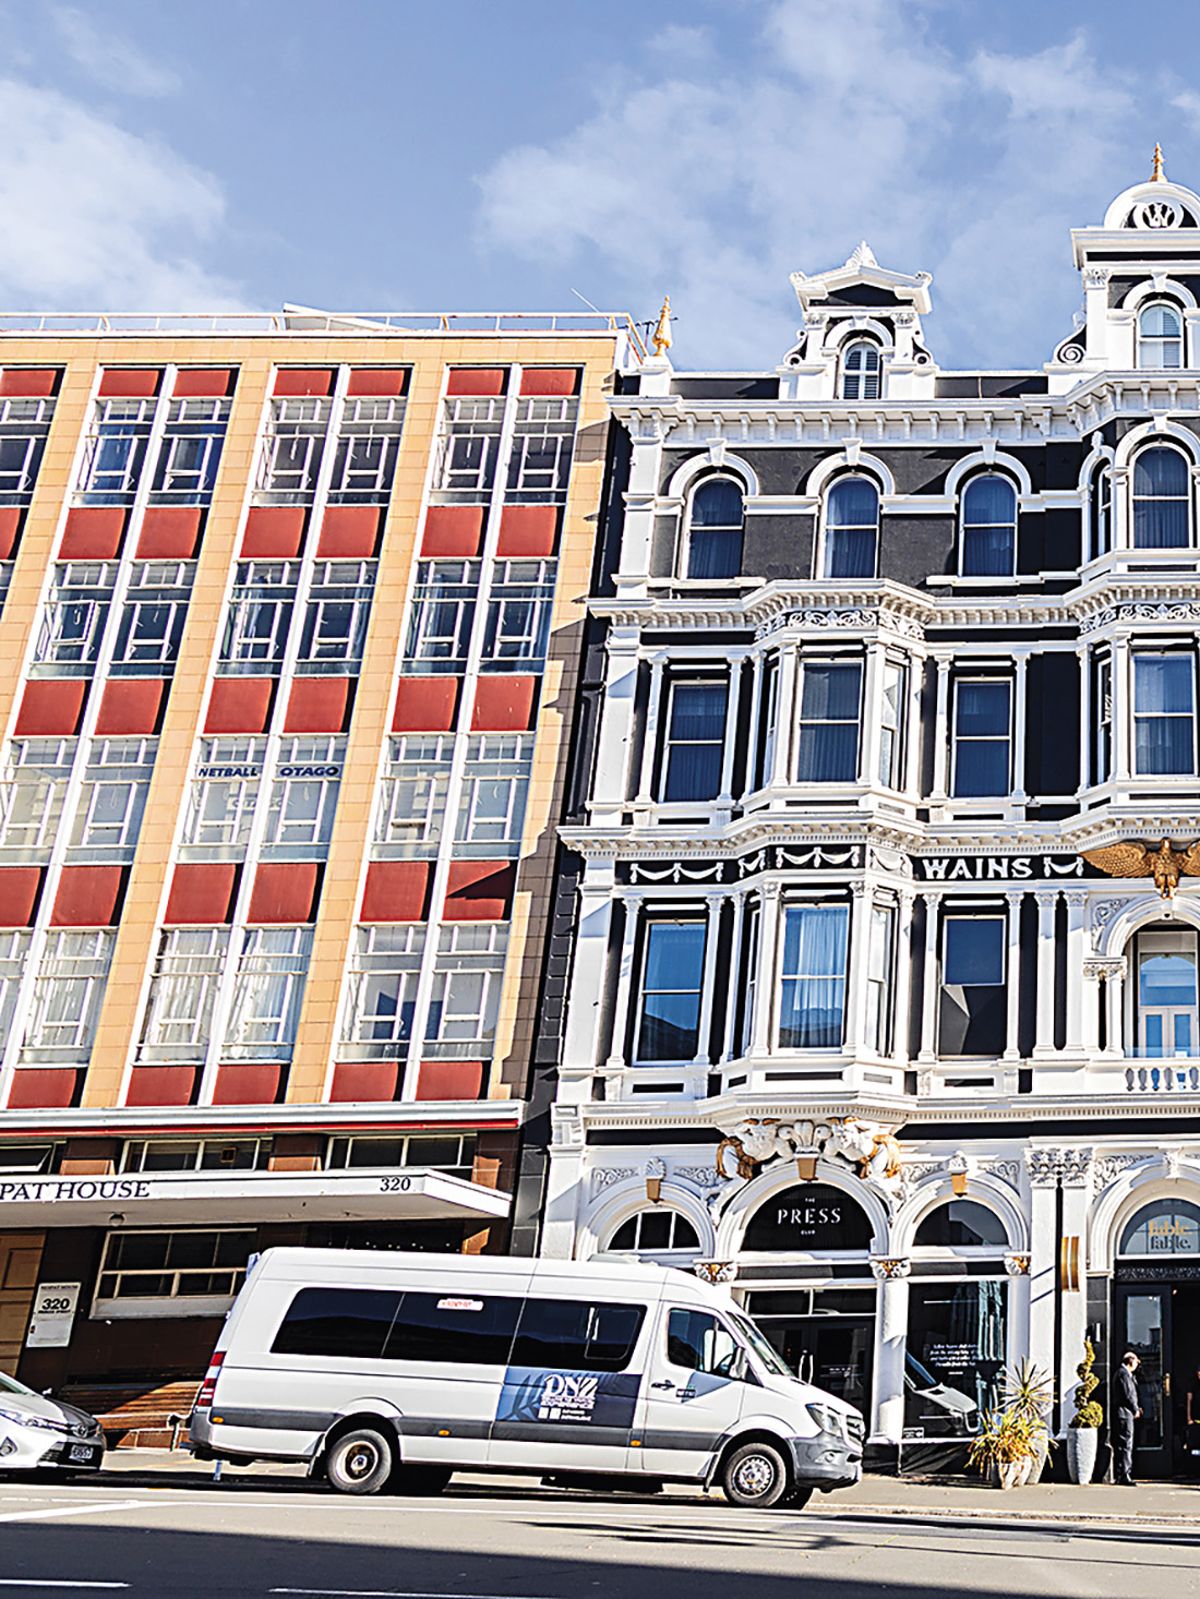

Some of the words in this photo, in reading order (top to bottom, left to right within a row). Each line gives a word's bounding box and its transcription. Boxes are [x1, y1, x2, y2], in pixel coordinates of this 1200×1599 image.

[198, 767, 257, 777] NETBALL
[280, 766, 339, 777] OTAGO
[922, 858, 1033, 879] WAINS
[55, 1180, 150, 1199] HOUSE
[380, 1176, 411, 1192] 320
[777, 1207, 841, 1224] PRESS
[42, 1297, 71, 1311] 320
